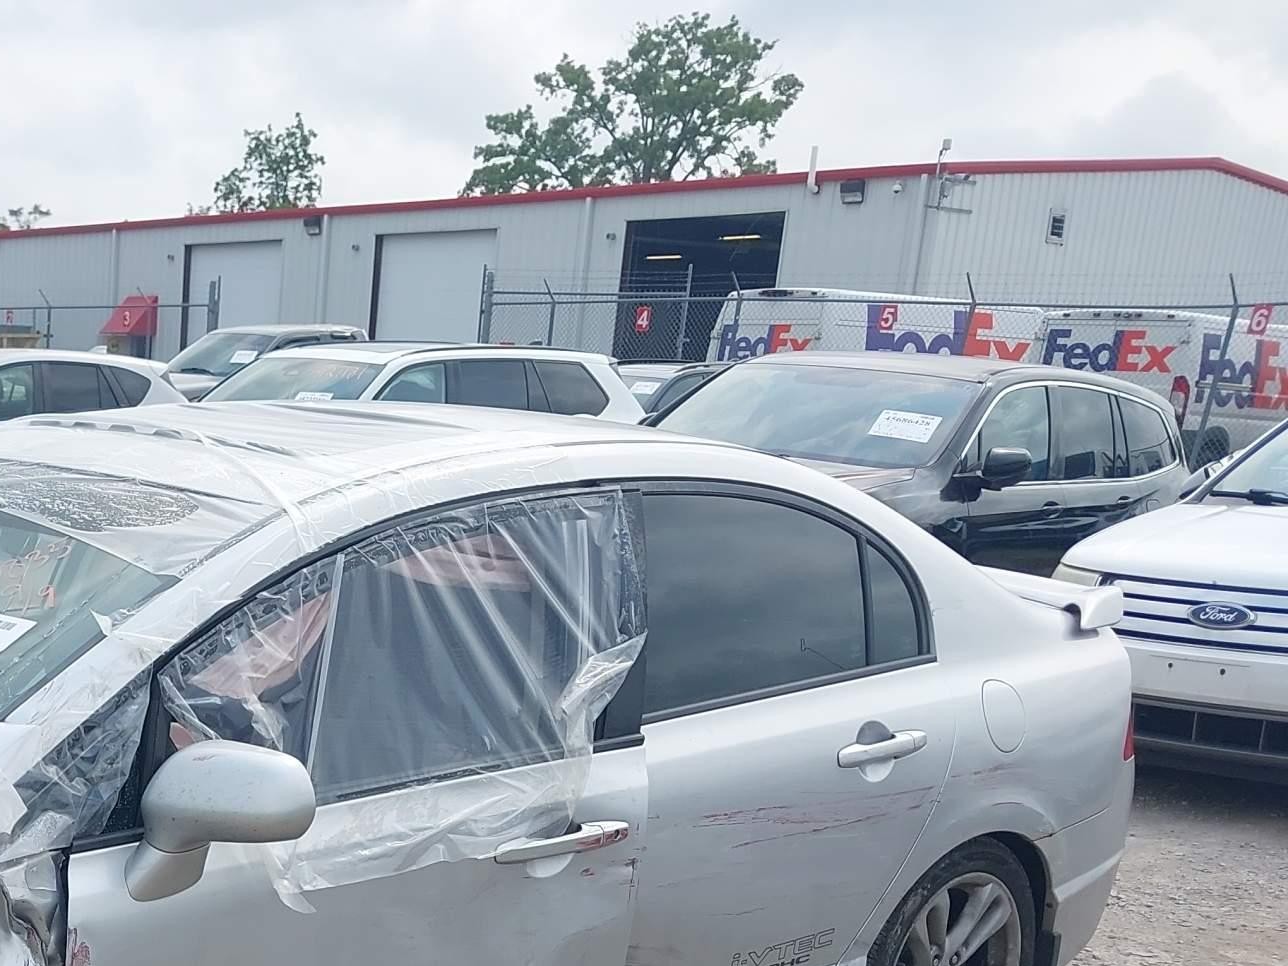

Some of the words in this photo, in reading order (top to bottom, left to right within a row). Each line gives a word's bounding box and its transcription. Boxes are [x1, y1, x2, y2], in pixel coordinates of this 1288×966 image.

[122, 311, 131, 326] 3
[636, 309, 650, 330] 4
[880, 307, 895, 328] 5
[1250, 308, 1270, 331] 6
[718, 324, 813, 361] FedEx
[1042, 328, 1177, 373] FedEx
[1199, 605, 1239, 622] Ford
